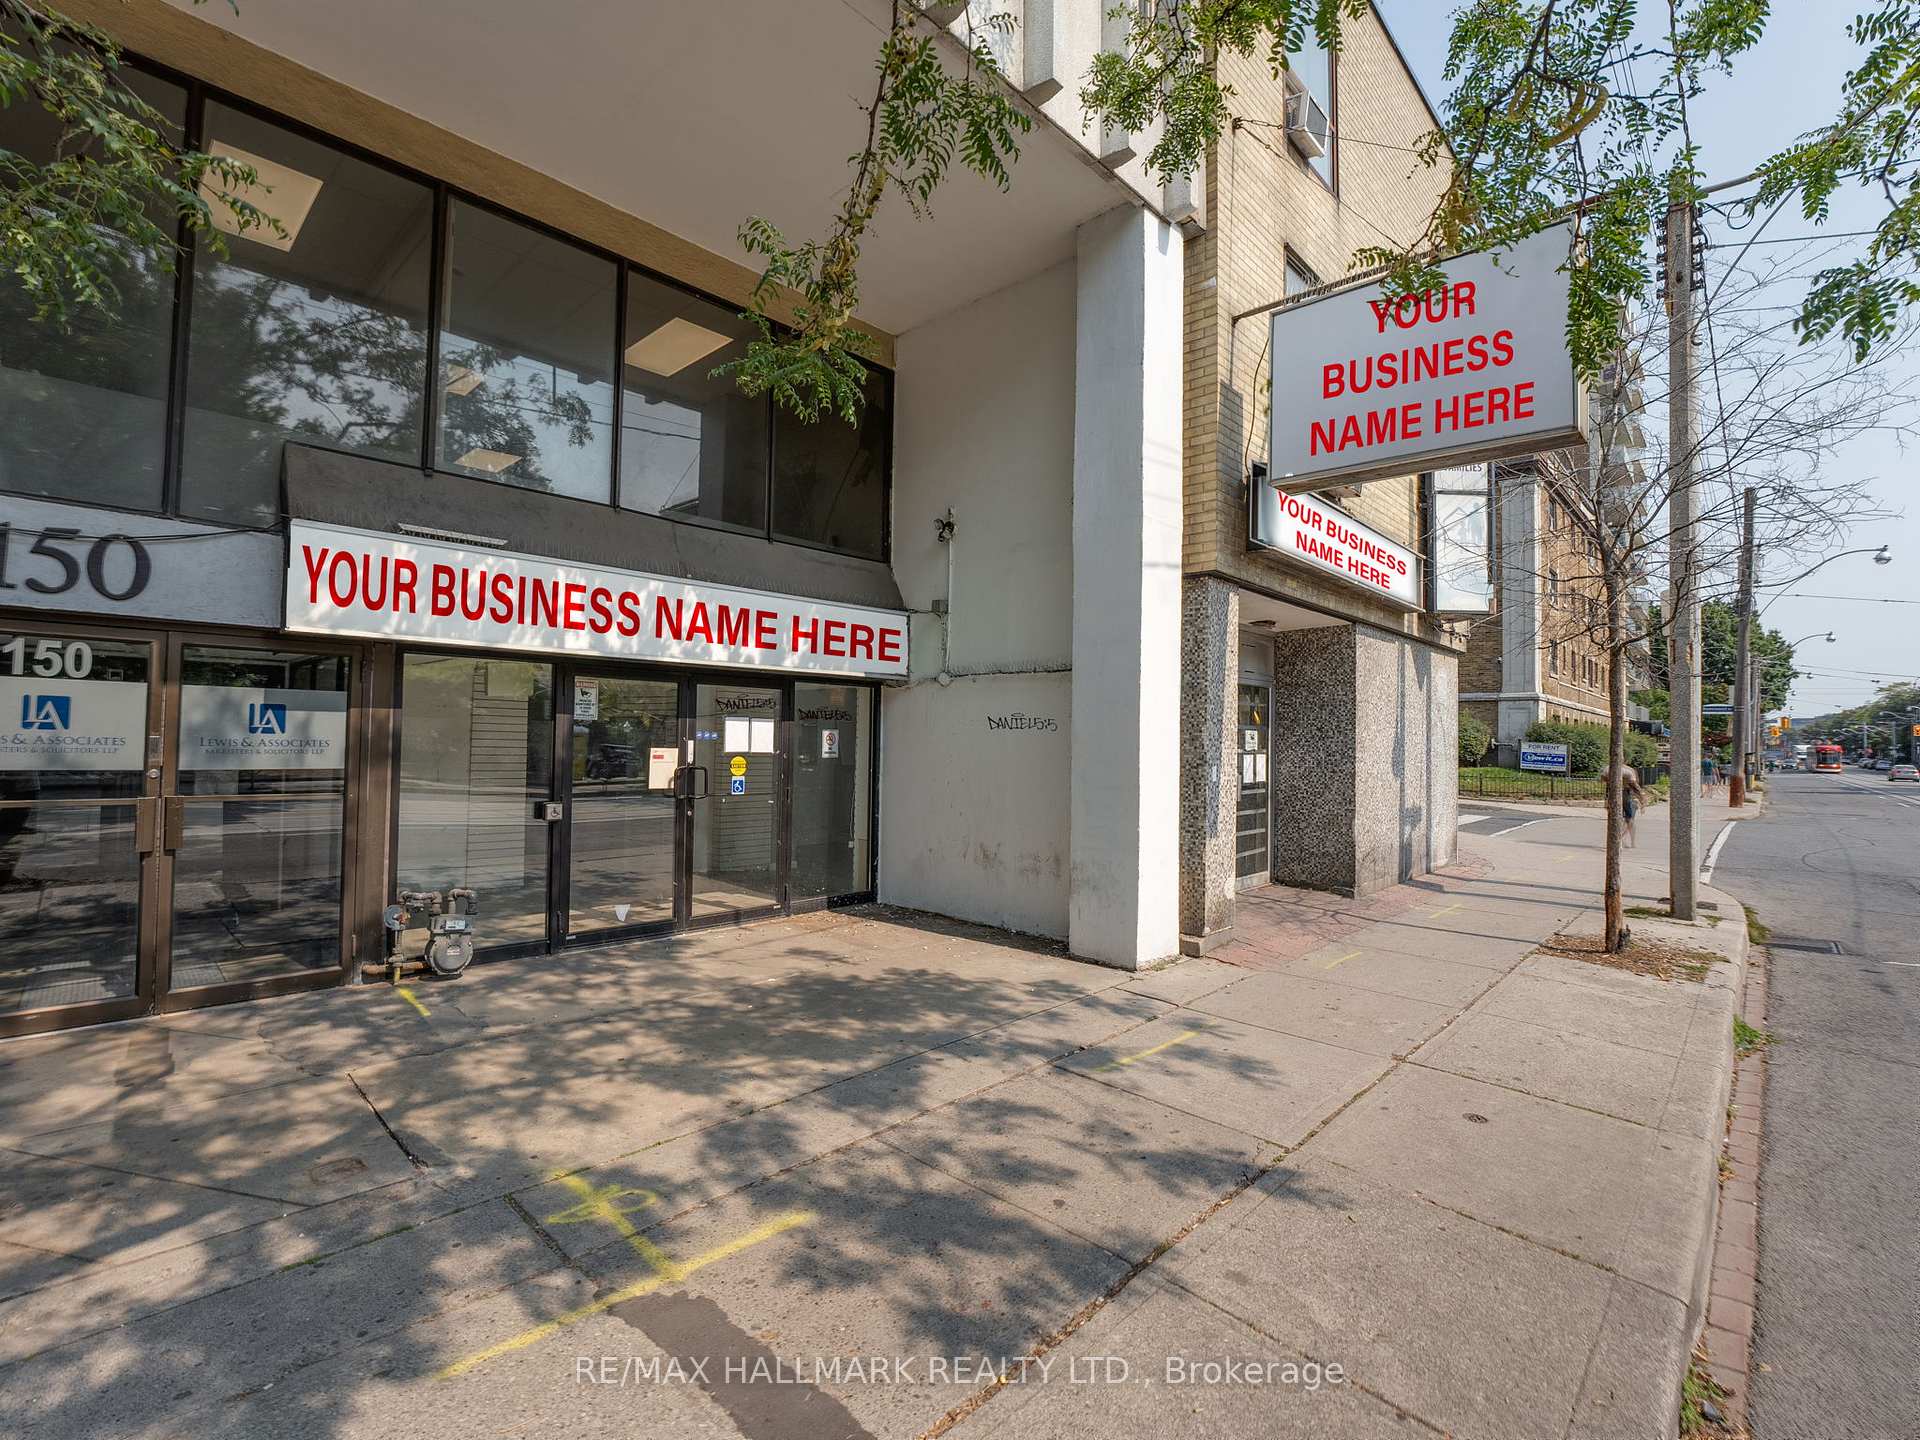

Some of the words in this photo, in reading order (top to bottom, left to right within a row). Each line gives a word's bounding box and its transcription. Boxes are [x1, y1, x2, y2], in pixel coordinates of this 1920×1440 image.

[1367, 281, 1476, 333] YOUR
[1323, 330, 1514, 399] BUSINESS
[1310, 403, 1422, 457] NAME
[1434, 382, 1535, 434] HERE
[0, 521, 152, 601] 150
[1277, 491, 1323, 532] YOUR
[1326, 520, 1407, 576] BUSINESS
[1296, 530, 1344, 569] NAME
[1348, 556, 1390, 589] HERE
[302, 545, 418, 614] YOUR
[431, 563, 640, 638] BUSINESS
[655, 595, 778, 650] NAME
[791, 615, 901, 662] HERE
[2, 637, 93, 679] 150
[33, 735, 126, 746] ASSOCIATES
[200, 736, 238, 747] LEWIS
[259, 738, 331, 748] ASSOCIATES
